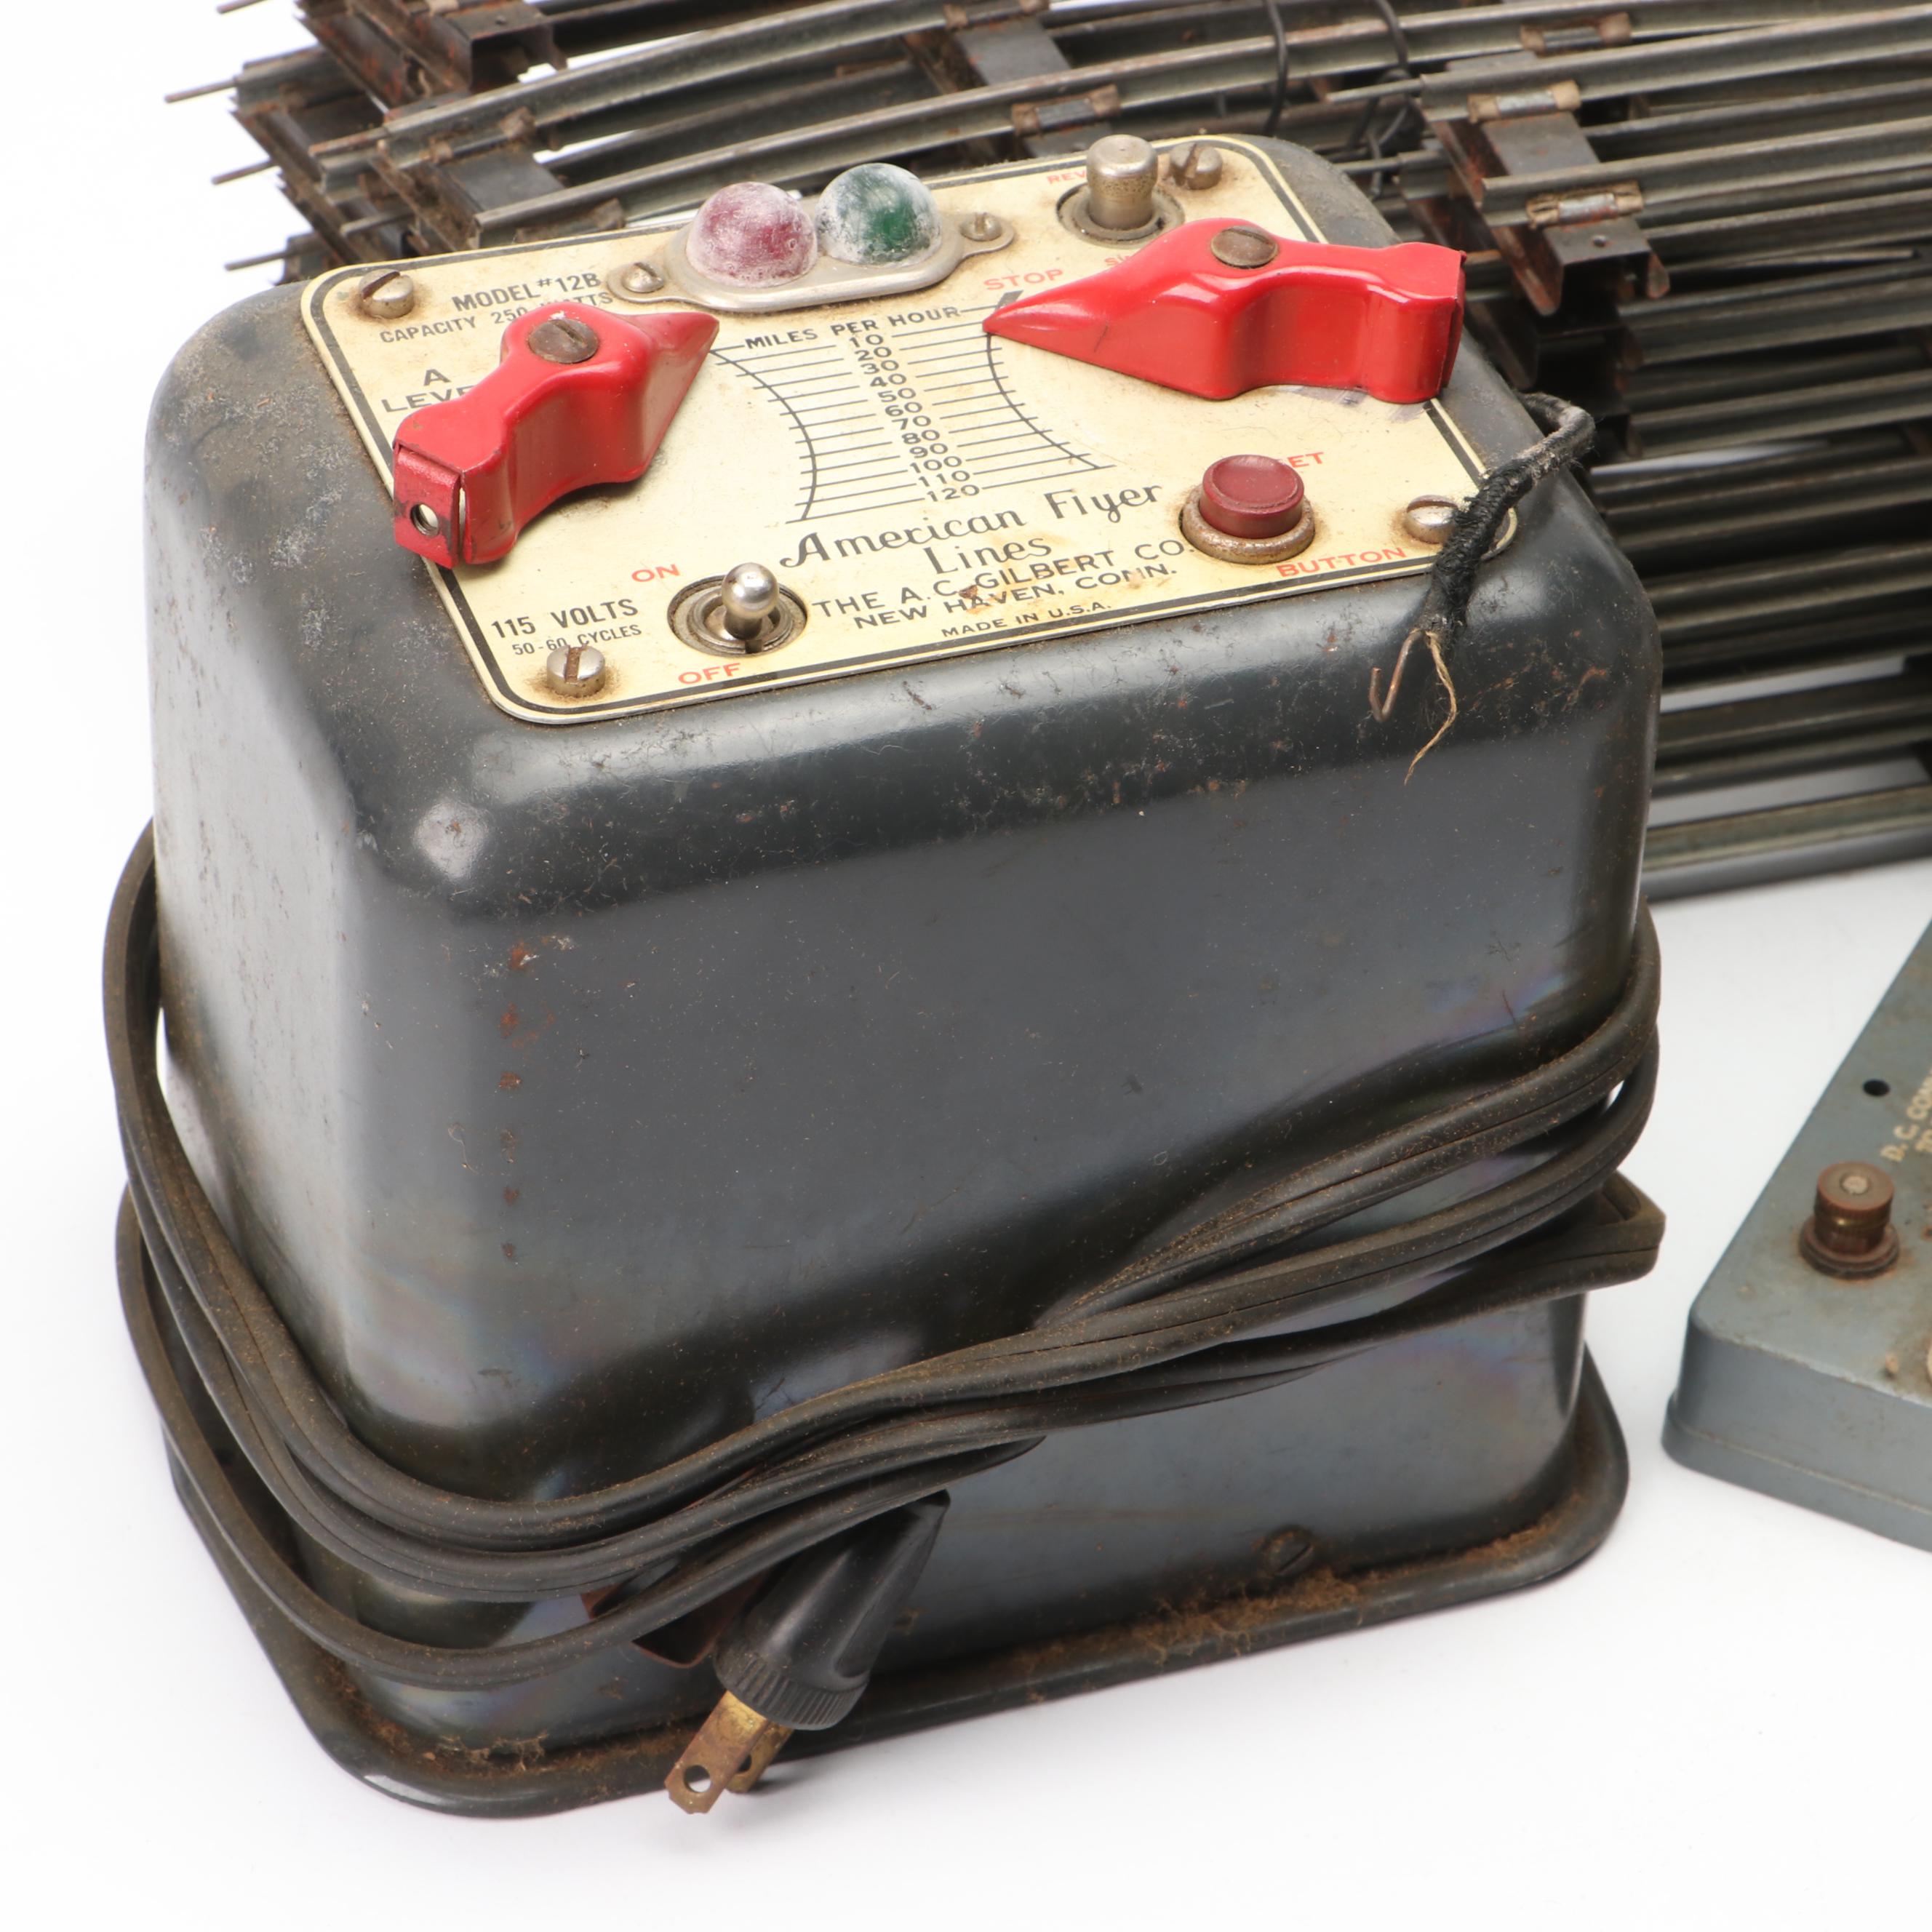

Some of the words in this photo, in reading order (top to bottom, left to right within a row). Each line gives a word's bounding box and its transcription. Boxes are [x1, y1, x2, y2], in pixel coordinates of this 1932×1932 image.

[983, 268, 1063, 291] STOP
[452, 283, 540, 311] MODEL
[537, 273, 601, 292] #12B
[380, 316, 477, 343] CAPACITY
[491, 306, 528, 324] 250
[745, 328, 818, 349] MILES
[830, 319, 879, 335] PER
[887, 306, 960, 327] HOUR
[849, 334, 883, 348] 10
[854, 346, 892, 361] 20
[423, 369, 451, 386] A
[860, 360, 899, 375] 30
[870, 373, 906, 387] 40
[877, 388, 916, 402] 50
[885, 402, 922, 417] 60
[891, 415, 931, 430] 70
[901, 429, 940, 444] 80
[909, 443, 948, 458] 90
[909, 456, 962, 473] 100
[918, 471, 970, 487] 110
[927, 484, 980, 502] 120
[780, 509, 1026, 567] American
[1045, 485, 1164, 523] Flyer
[923, 537, 1052, 575] Lines
[1276, 546, 1407, 578] BUTTON
[631, 563, 680, 583] ON
[811, 591, 885, 617] THE
[975, 550, 1114, 588] GILBERT
[1135, 540, 1194, 560] CO.
[853, 605, 926, 629] NEW
[943, 583, 1064, 613] HAVEN,
[1075, 564, 1177, 589] CONN.
[490, 616, 536, 639] 115
[551, 598, 639, 629] VOLTS
[941, 618, 1008, 637] MADE
[1015, 613, 1039, 625] IN
[1047, 602, 1111, 618] U.S.A.
[577, 624, 642, 647] CYCLES
[678, 663, 741, 684] OFF
